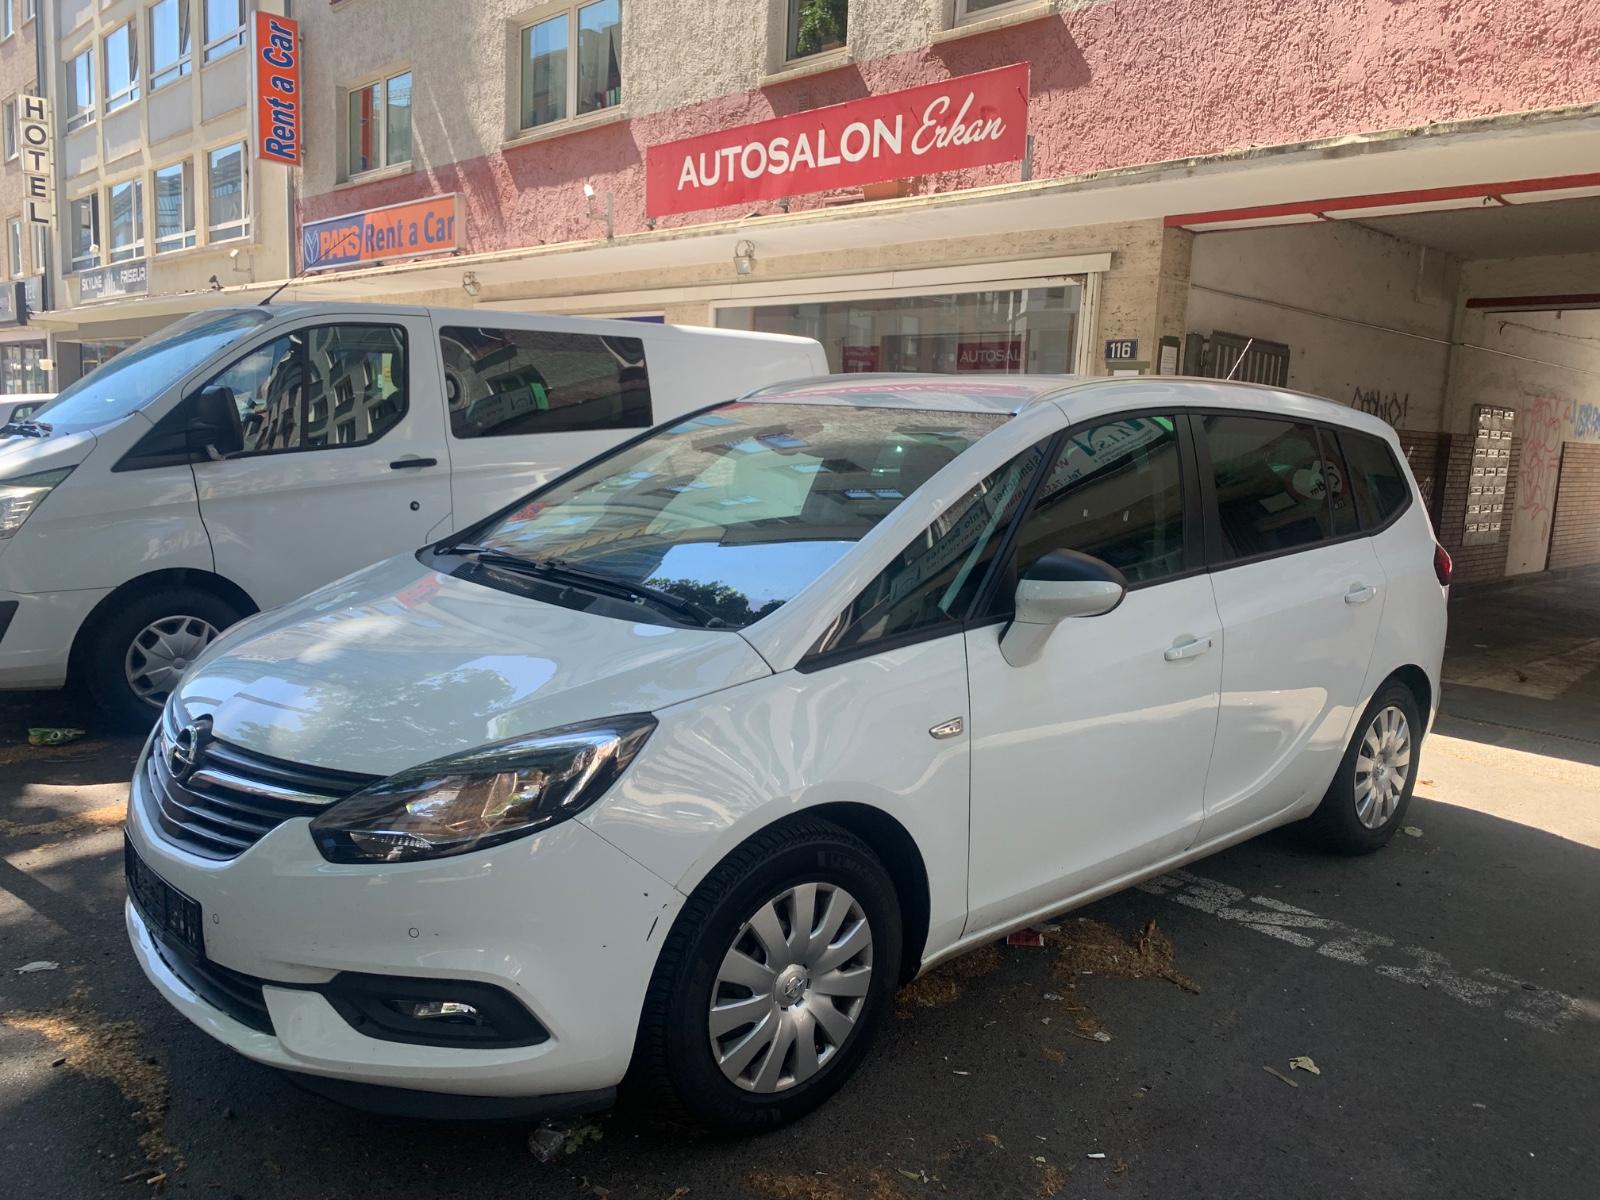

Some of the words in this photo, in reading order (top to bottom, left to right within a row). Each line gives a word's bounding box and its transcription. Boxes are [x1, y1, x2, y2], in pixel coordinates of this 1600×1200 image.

[262, 19, 295, 68] Car
[271, 75, 295, 94] a
[263, 95, 296, 161] Rent
[677, 115, 903, 191] AUTOSALON
[911, 92, 1006, 155] Erkan
[25, 98, 49, 223] HOTEL
[319, 224, 361, 261] PARS
[365, 220, 401, 253] Rent
[409, 222, 418, 247] a
[424, 211, 455, 243] Car
[120, 267, 146, 283] FRISEUR
[960, 348, 1021, 362] AUTOSAL
[1110, 342, 1132, 358] 116
